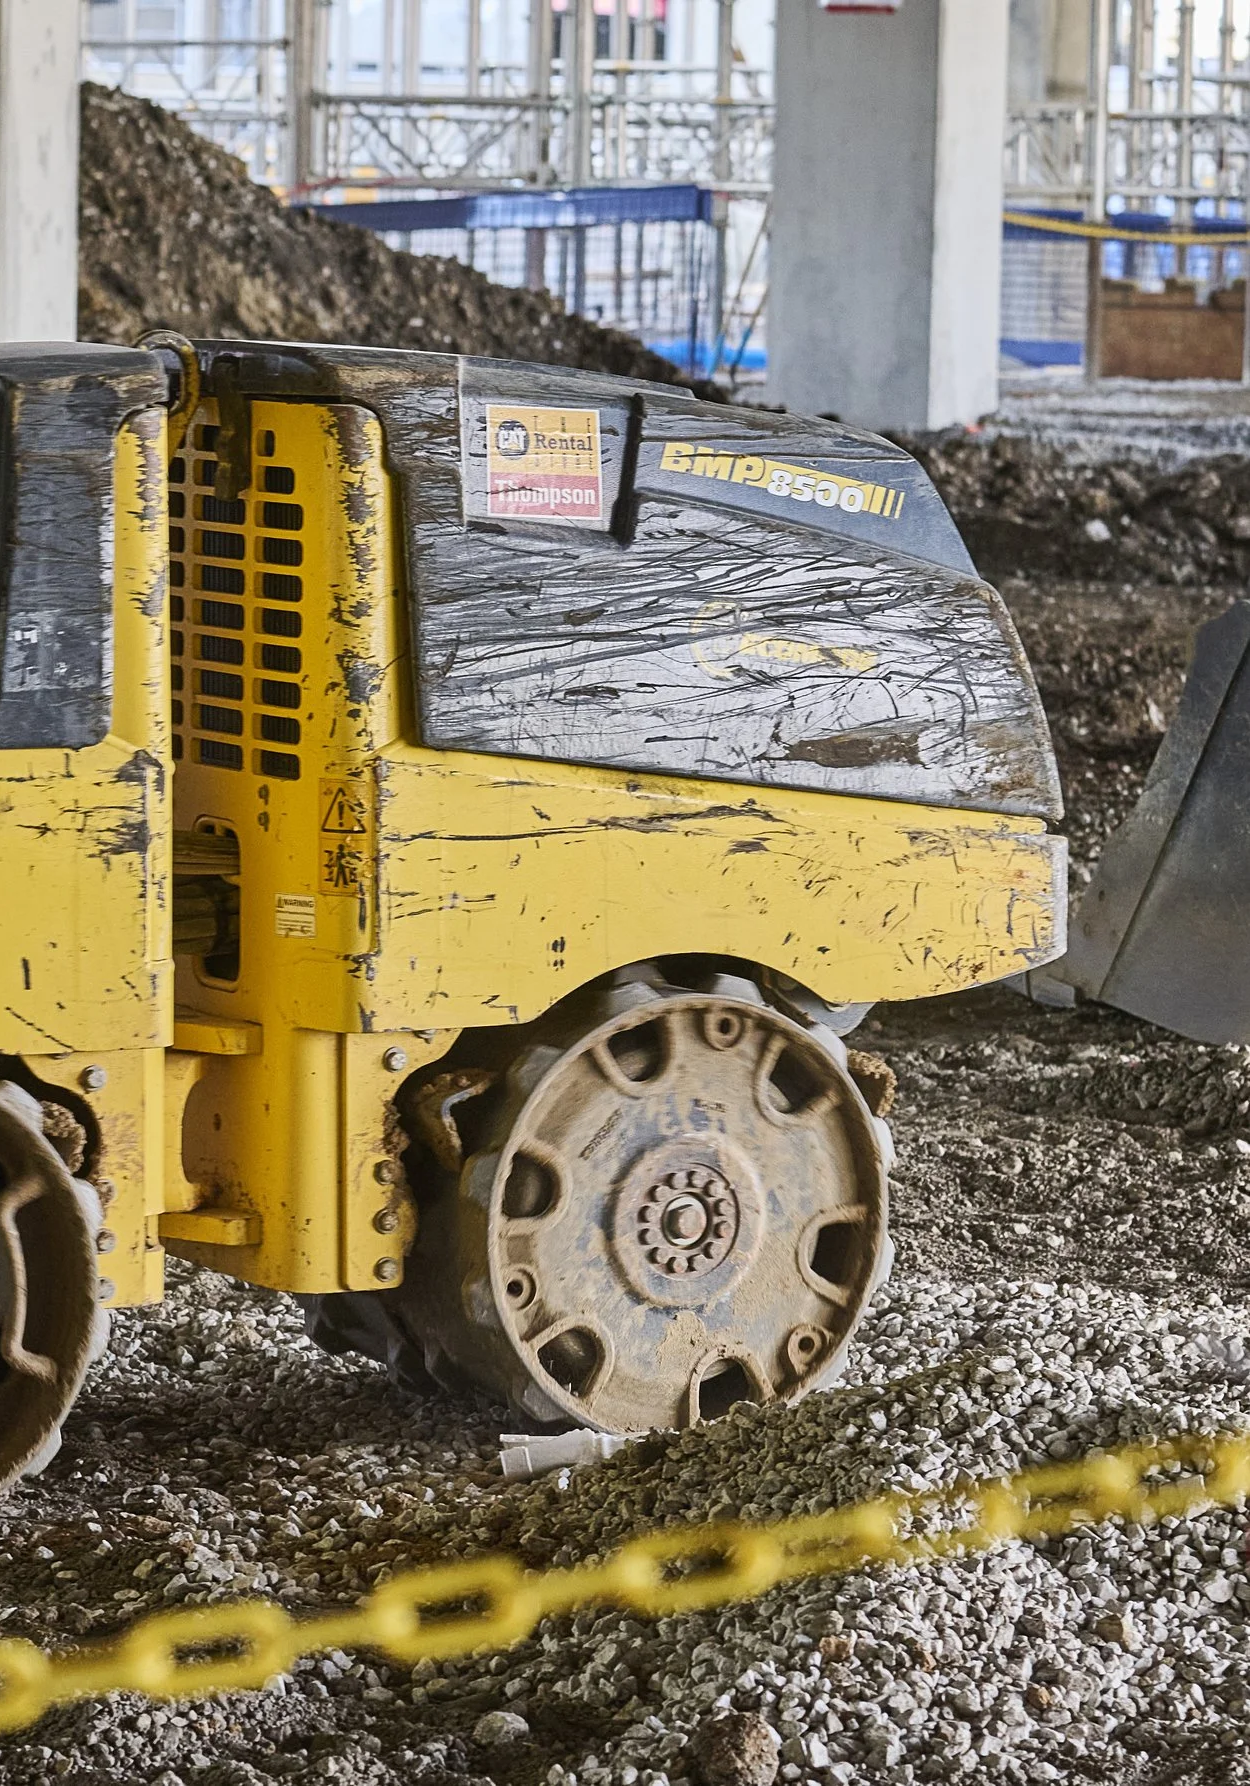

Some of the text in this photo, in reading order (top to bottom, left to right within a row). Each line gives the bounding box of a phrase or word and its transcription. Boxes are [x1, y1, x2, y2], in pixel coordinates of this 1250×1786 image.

[497, 427, 527, 450] CAT
[533, 433, 594, 451] Rental
[493, 479, 596, 510] Thompson
